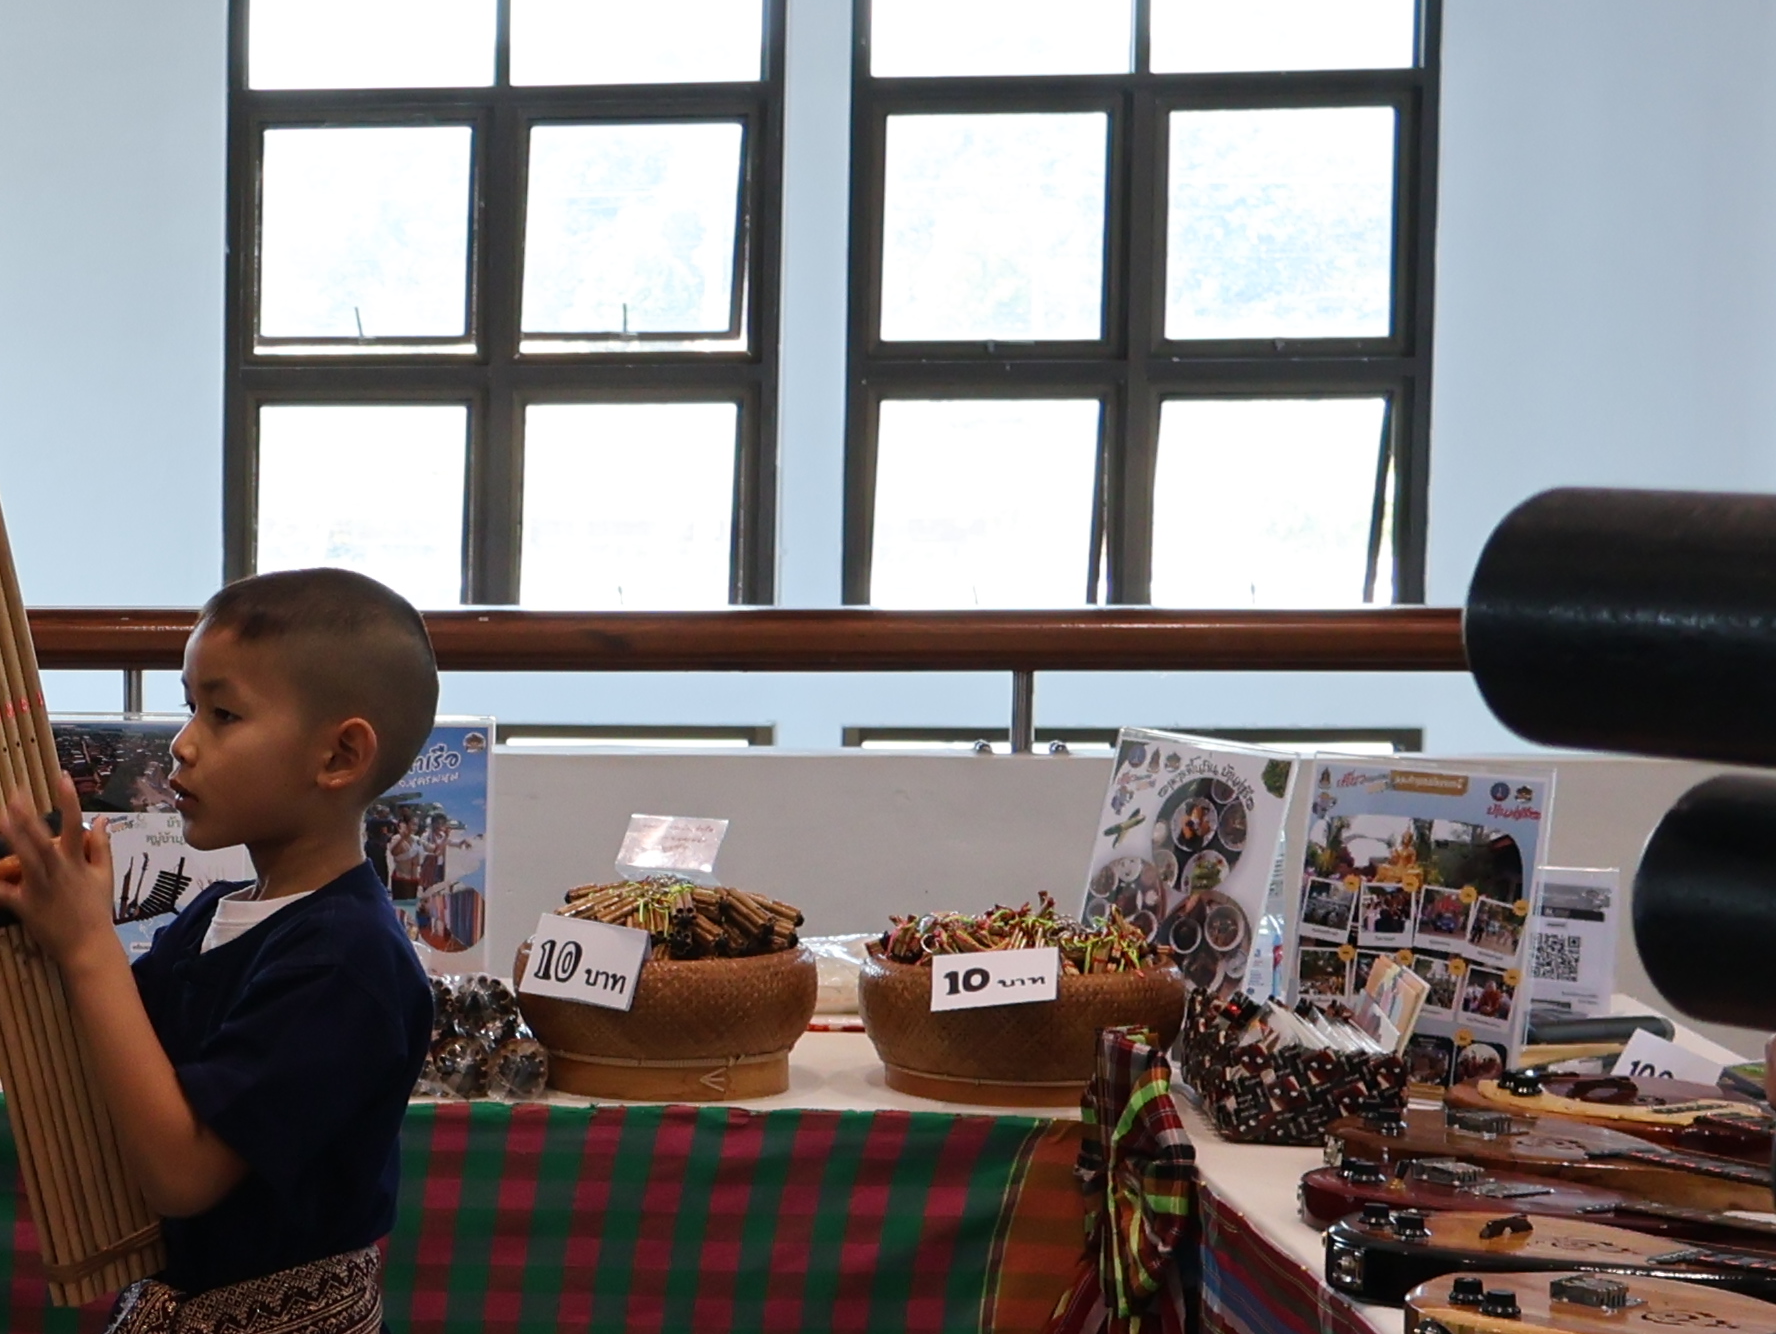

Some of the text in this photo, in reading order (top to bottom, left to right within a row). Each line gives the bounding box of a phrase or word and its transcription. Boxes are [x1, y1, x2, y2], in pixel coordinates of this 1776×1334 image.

[533, 938, 627, 995] 10 บาท
[943, 967, 1047, 996] 10 บาท
